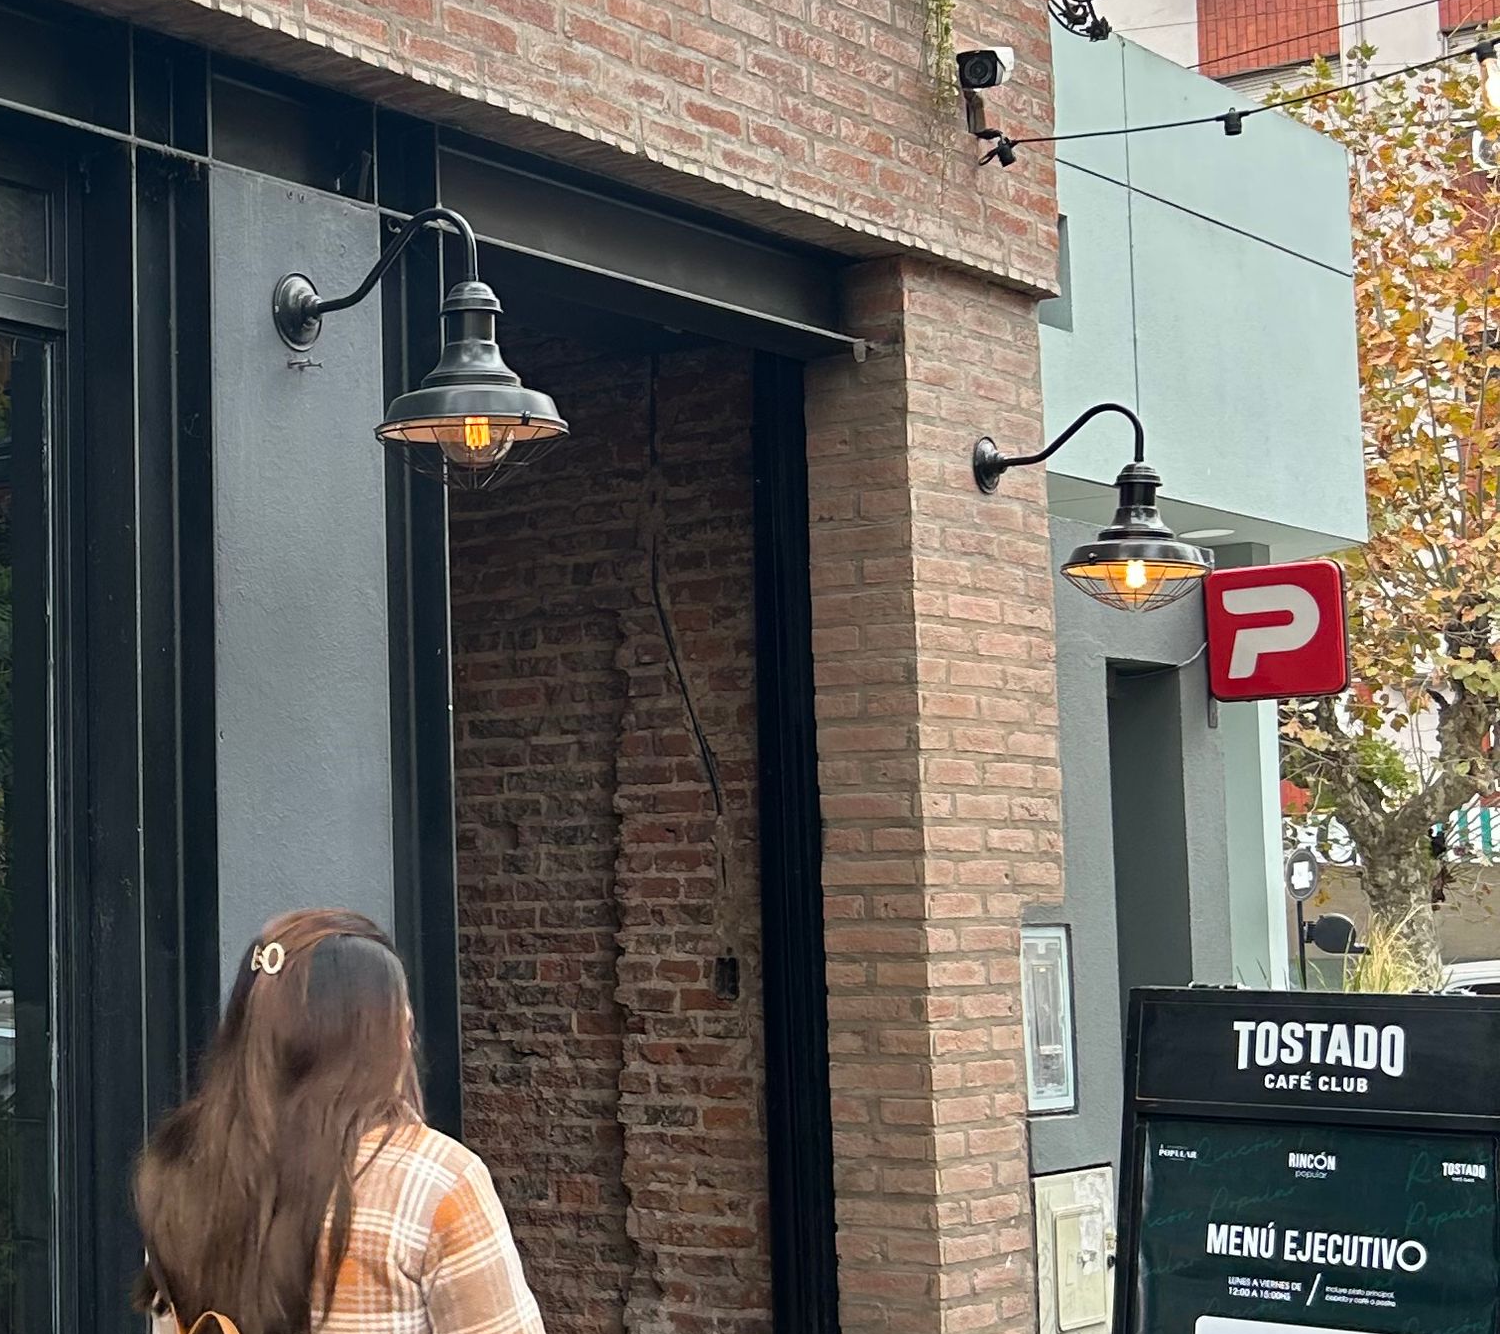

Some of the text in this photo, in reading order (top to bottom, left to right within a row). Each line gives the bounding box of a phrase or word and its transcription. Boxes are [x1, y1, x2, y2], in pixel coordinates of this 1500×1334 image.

[1222, 584, 1320, 679] P
[1233, 1020, 1405, 1077] TOSTADO
[1264, 1071, 1368, 1094] CAFÉ CLUB
[1288, 1151, 1336, 1171] RINCÓN
[1442, 1162, 1486, 1179] TOSTADO
[1295, 1169, 1328, 1179] popular
[1206, 1222, 1427, 1272] MENÚ EJECUTIVO
